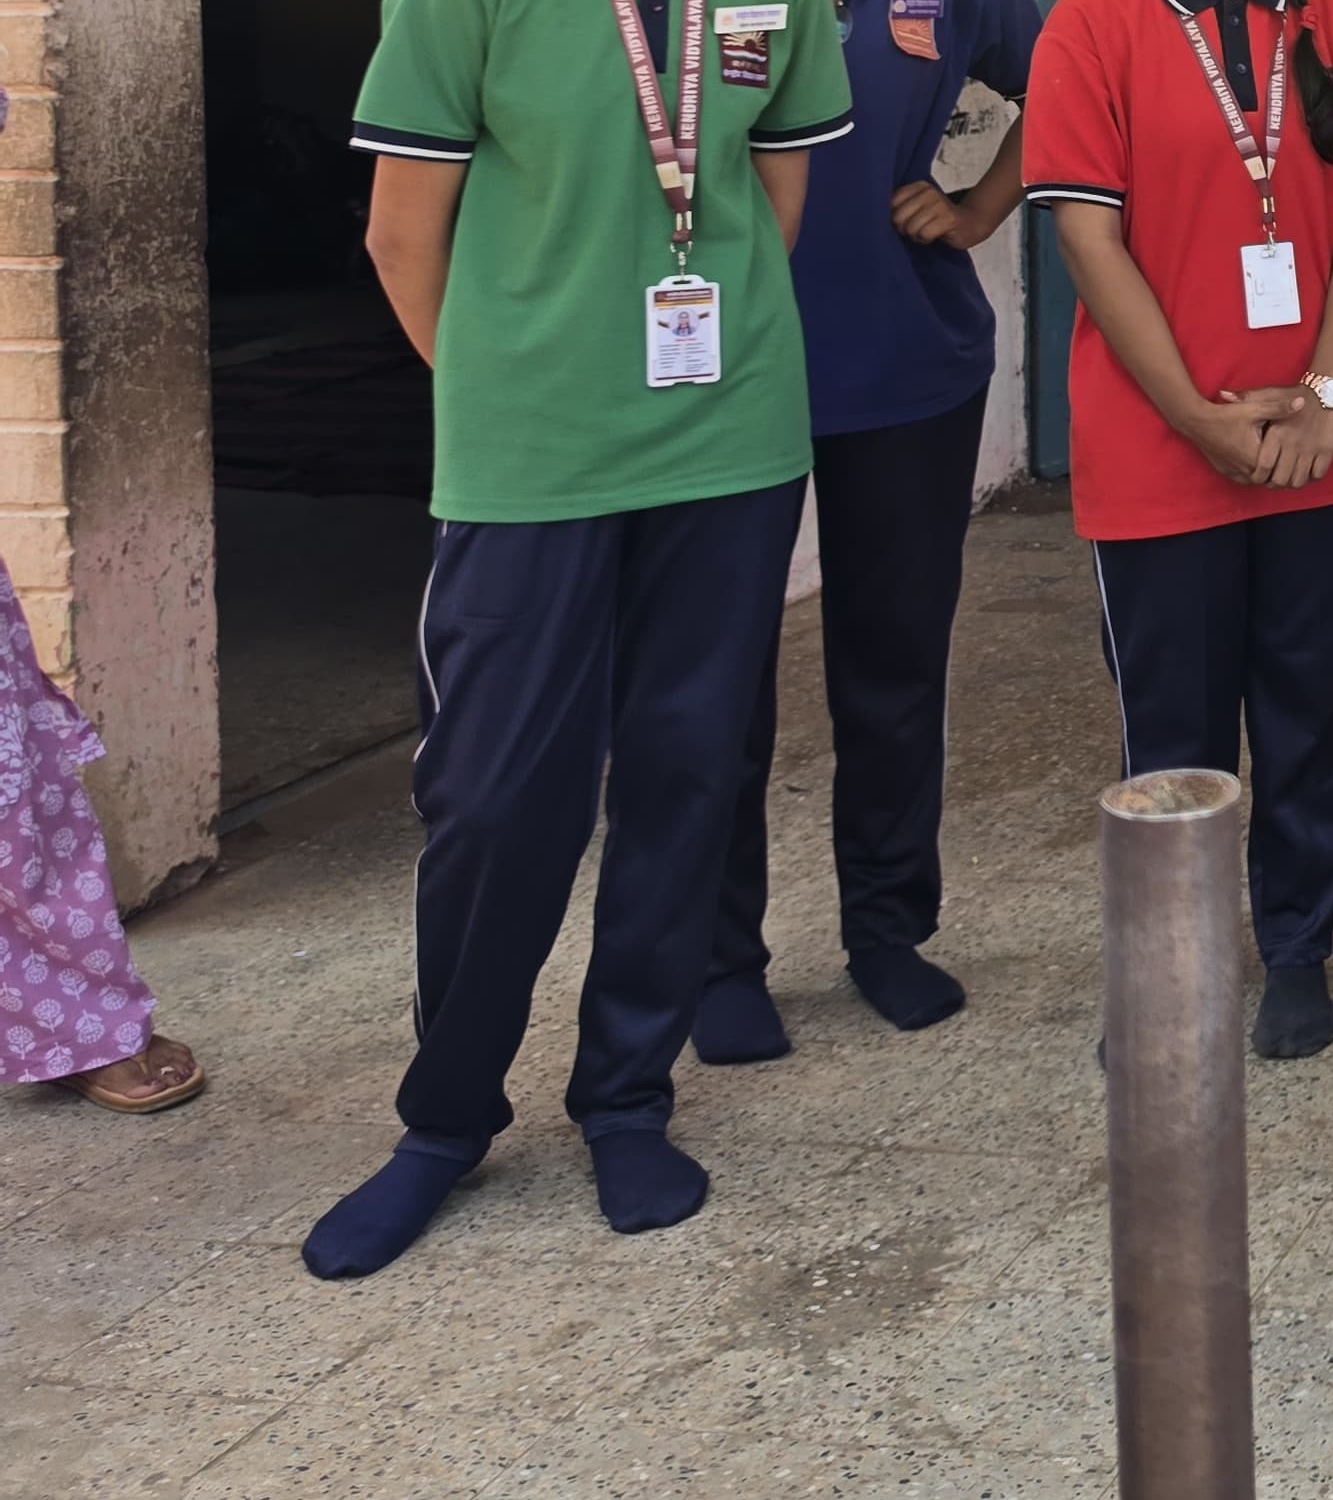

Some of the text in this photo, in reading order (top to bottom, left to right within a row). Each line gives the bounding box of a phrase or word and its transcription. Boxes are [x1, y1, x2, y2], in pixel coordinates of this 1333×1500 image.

[634, 64, 664, 132] KENDRIYA
[679, 72, 699, 141] KENDRIYA
[1184, 19, 1246, 134] KENDRIYA VIDYALAYA
[1269, 72, 1284, 131] KENDRIYA
